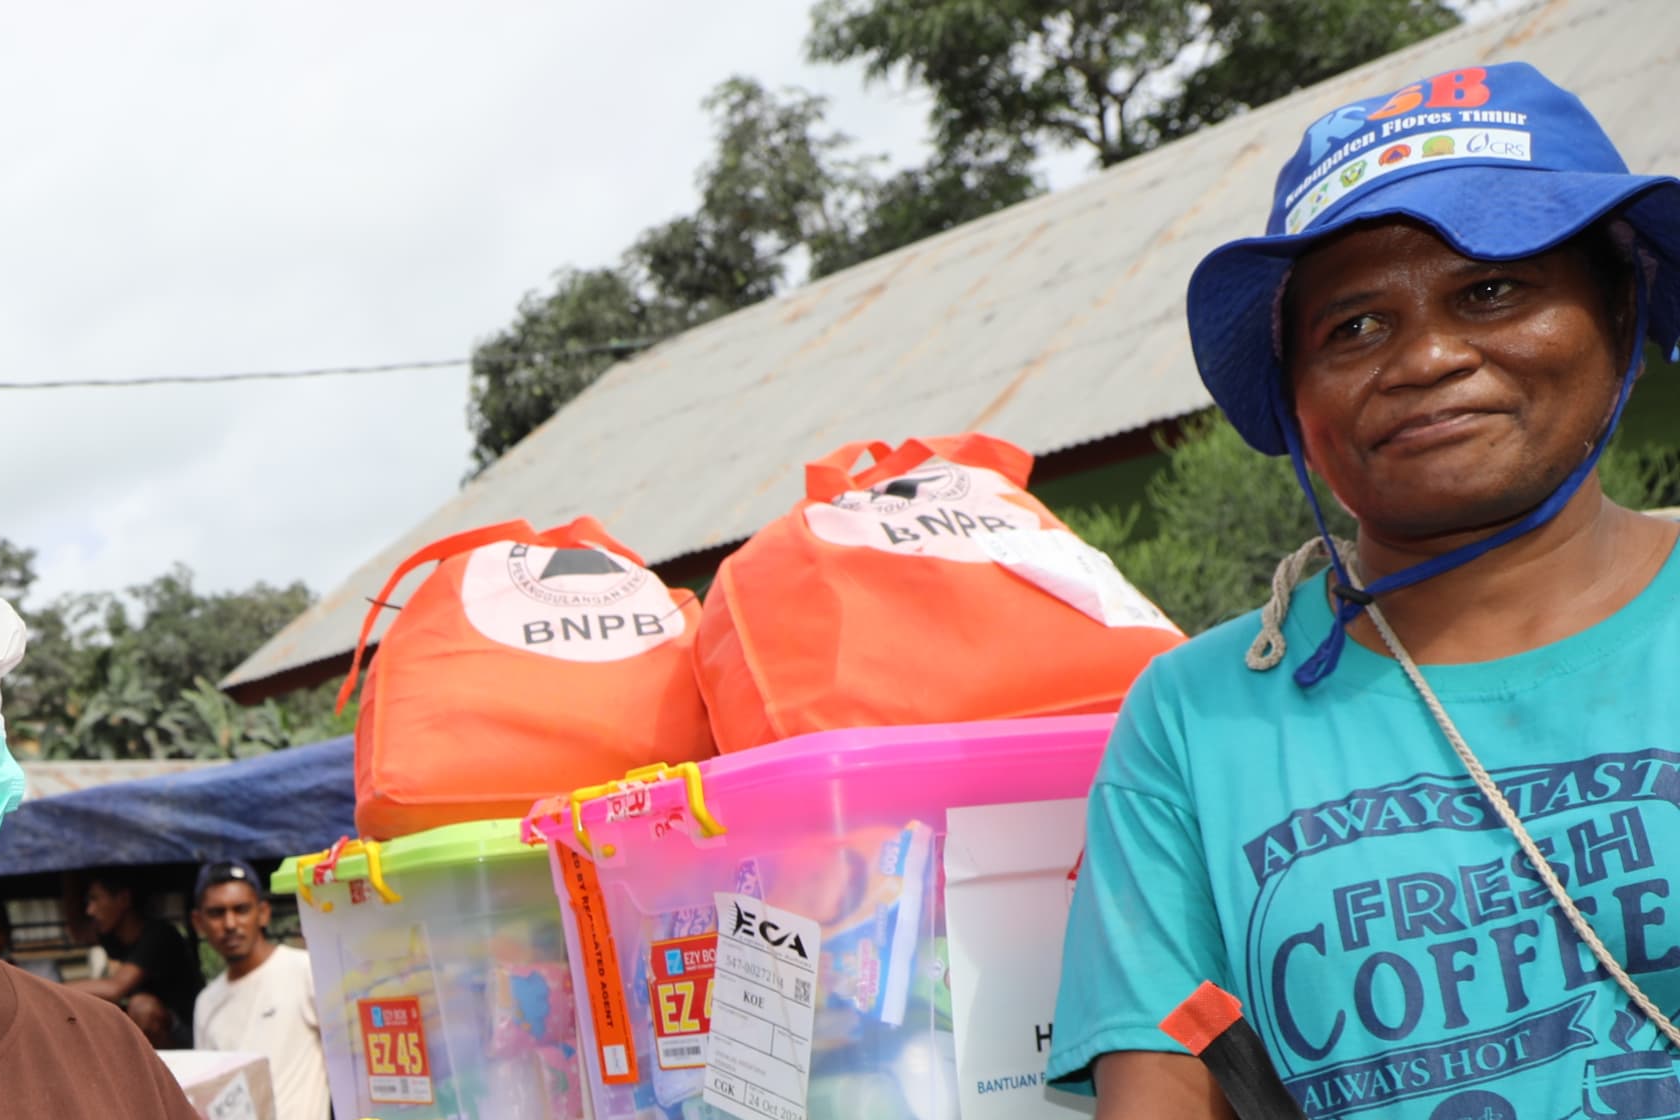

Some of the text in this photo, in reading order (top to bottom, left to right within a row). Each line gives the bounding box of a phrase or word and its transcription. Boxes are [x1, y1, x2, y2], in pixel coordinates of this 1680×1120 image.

[1308, 66, 1492, 167] KSB
[1380, 108, 1452, 140] Flores
[1458, 109, 1527, 127] Timur
[1489, 140, 1525, 157] CRS
[523, 613, 664, 644] BNPB
[1262, 788, 1486, 878] ALWAYS
[1332, 807, 1655, 952] FRESH
[732, 901, 808, 960] ECA
[1272, 877, 1680, 1062] COFFEE
[368, 1032, 423, 1074] EZ 45
[1302, 1030, 1531, 1114] ALWAYS HOT
[976, 1072, 1037, 1094] BANTUAN
